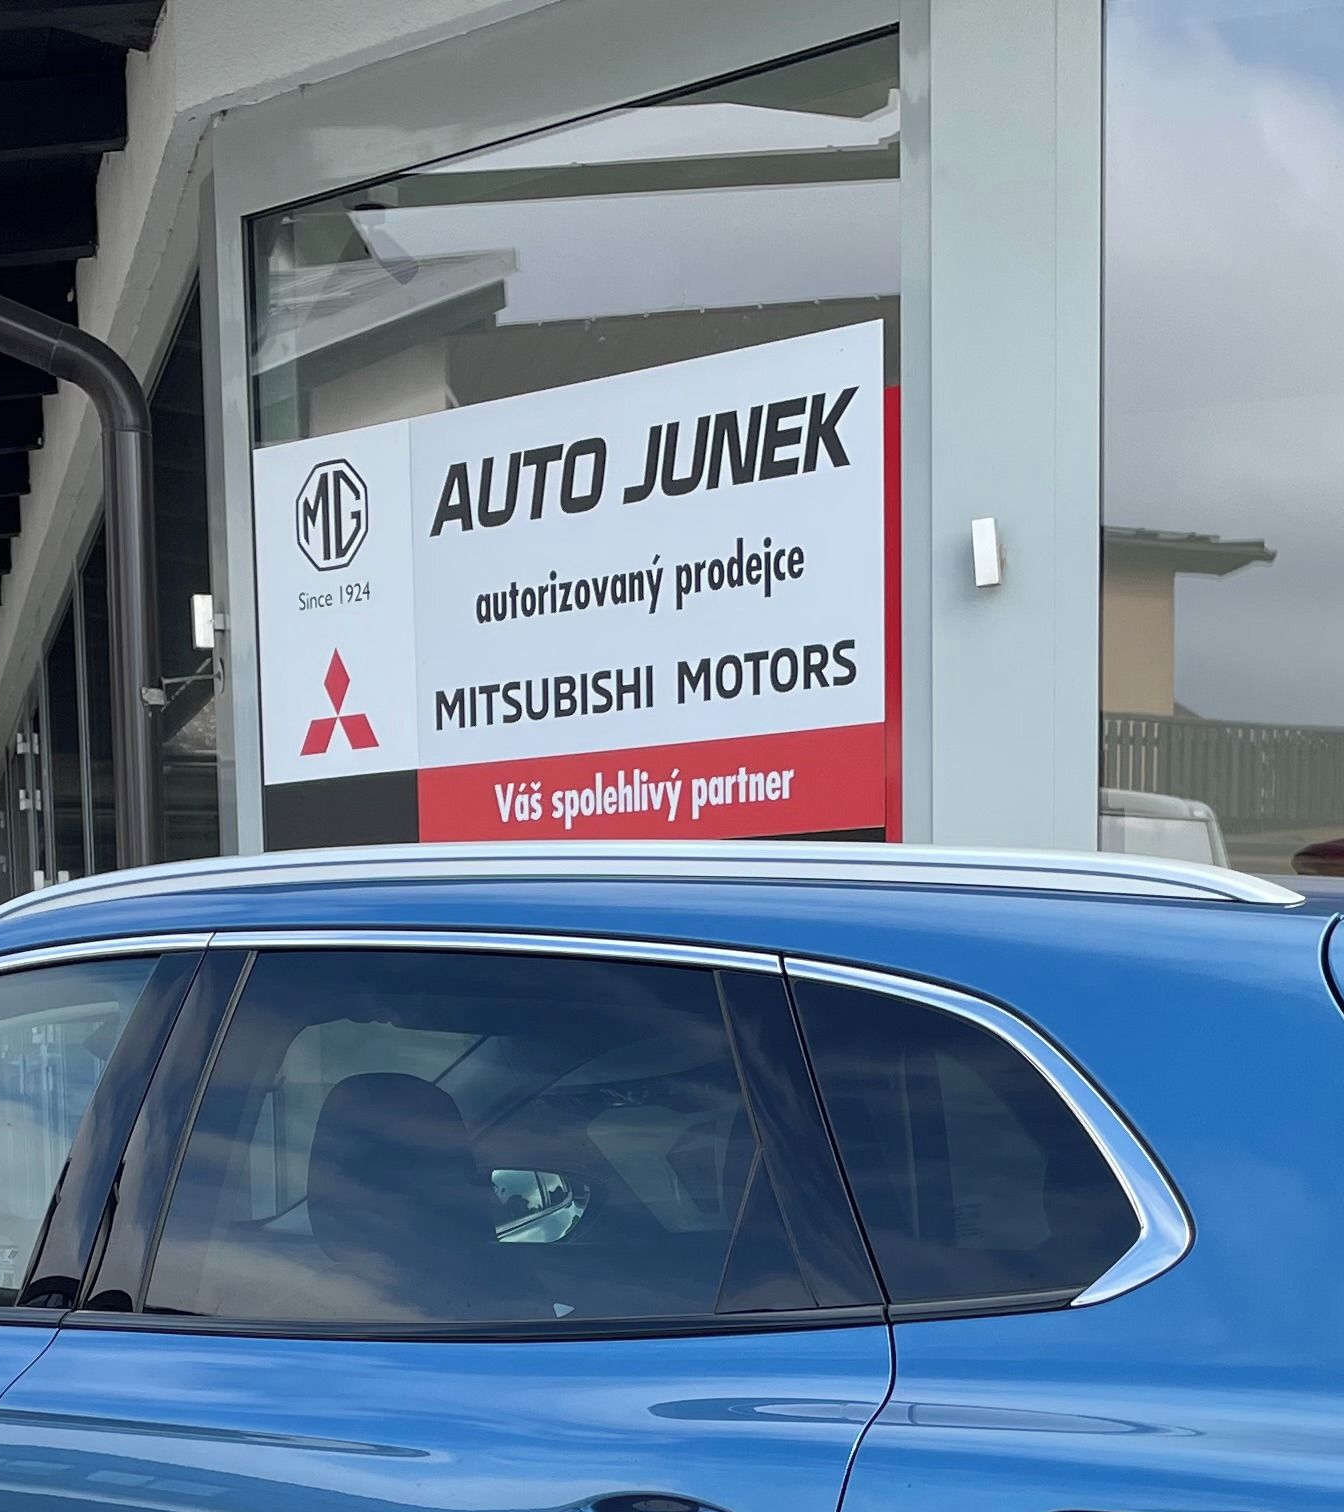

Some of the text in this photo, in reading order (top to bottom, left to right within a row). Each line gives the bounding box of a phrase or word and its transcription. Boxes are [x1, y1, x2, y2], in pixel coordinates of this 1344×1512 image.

[430, 386, 860, 537] AUTO JUNEK
[300, 462, 363, 561] MG
[298, 581, 370, 611] Since 1924
[476, 537, 805, 625] autorizovaný prodejce
[435, 639, 857, 731] MITSUBISHI MOTORS
[494, 763, 794, 830] Váš spolehlivý partner
